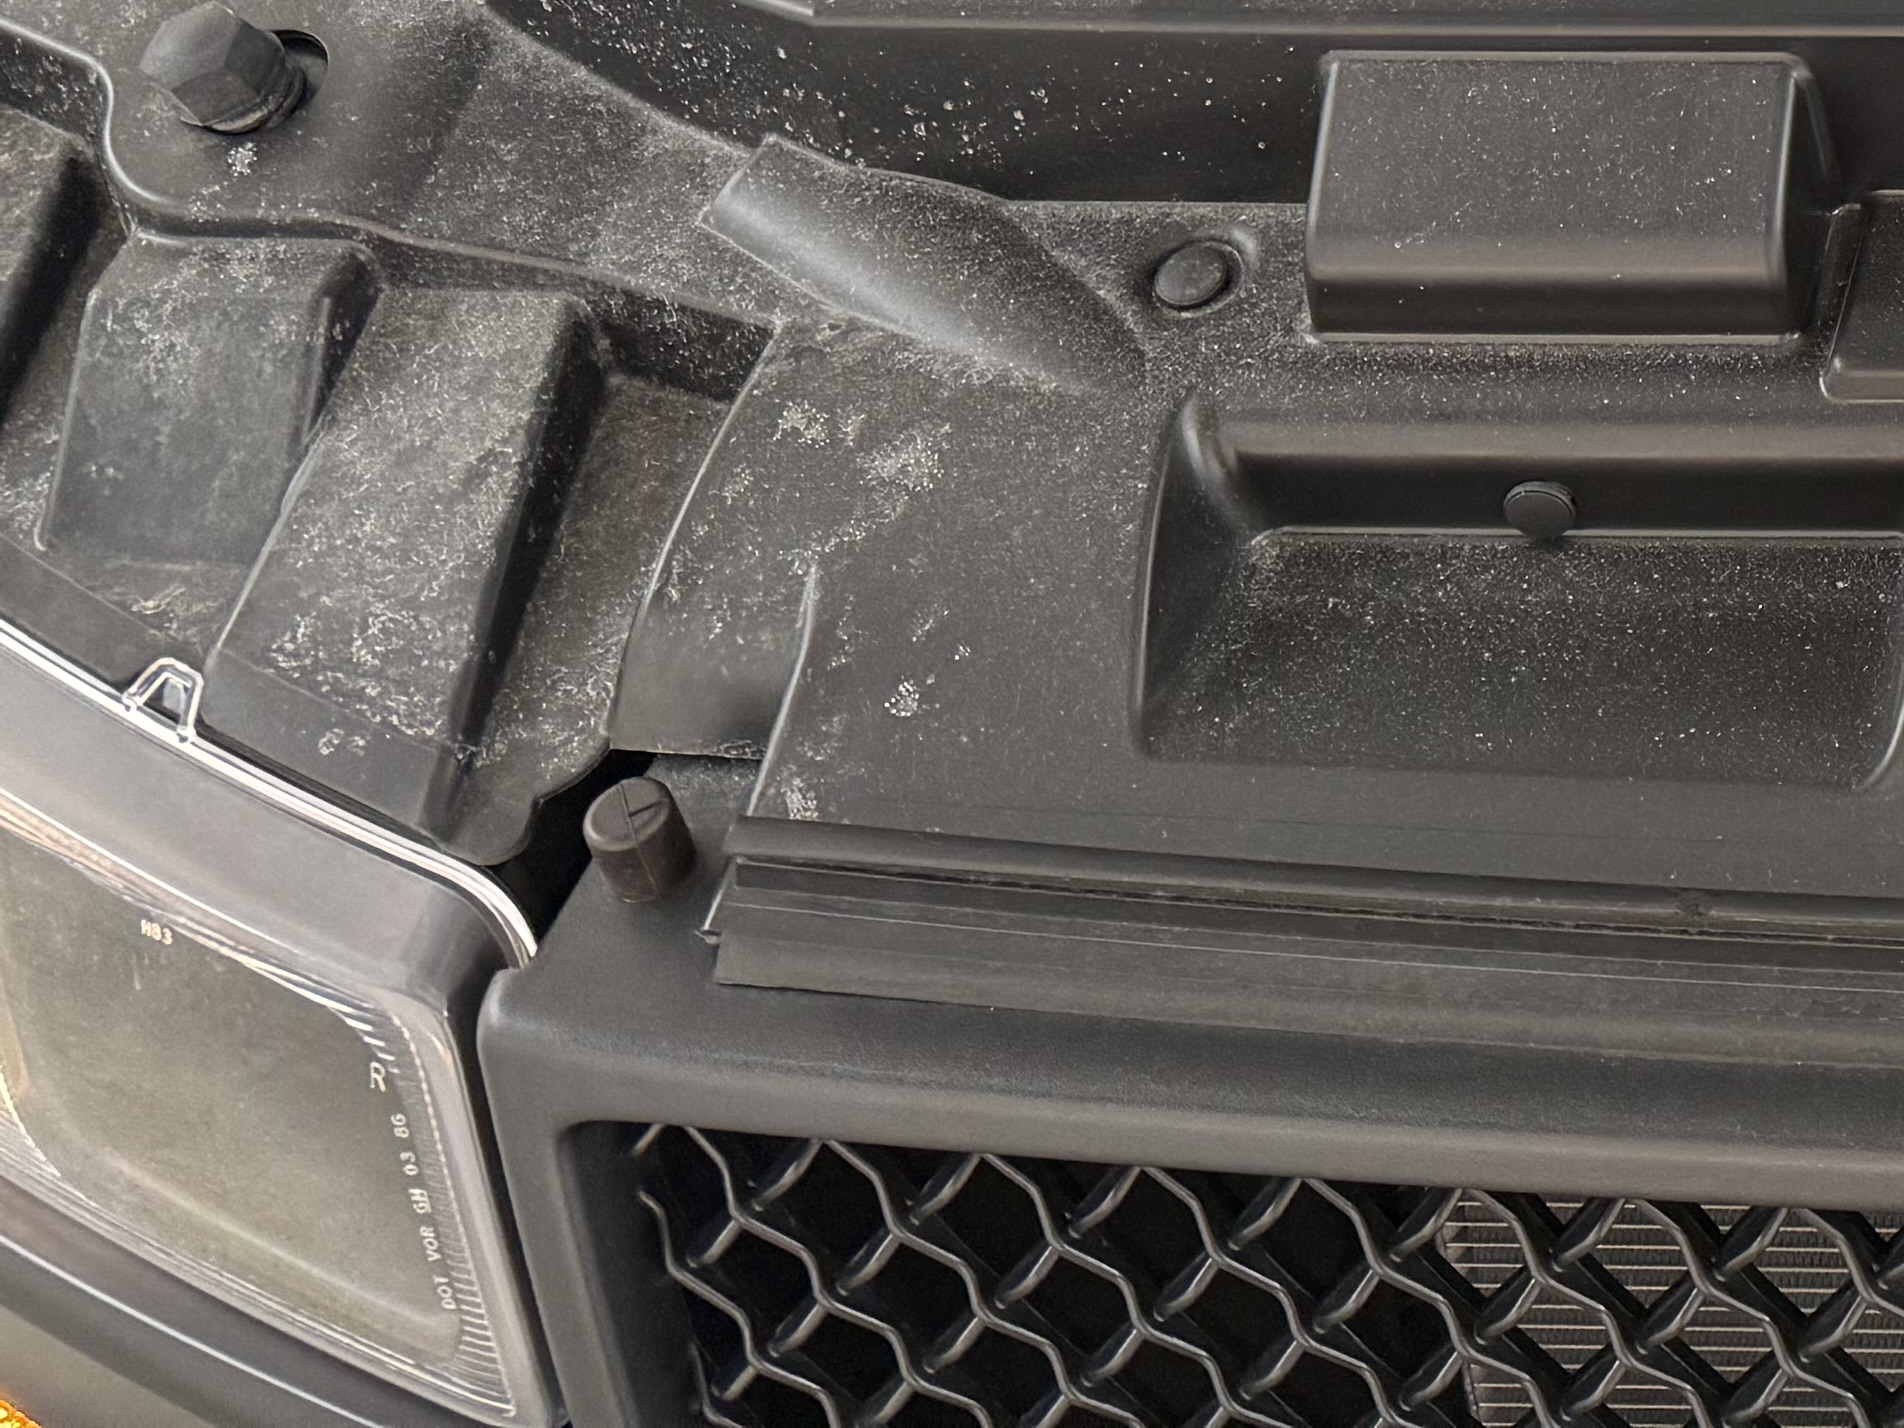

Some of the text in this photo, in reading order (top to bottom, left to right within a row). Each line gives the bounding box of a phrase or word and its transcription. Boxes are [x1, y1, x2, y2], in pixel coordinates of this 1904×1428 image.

[370, 1061, 387, 1092] R
[400, 1151, 419, 1176] 03
[419, 1226, 443, 1262] VOR
[433, 1275, 457, 1310] DOT
